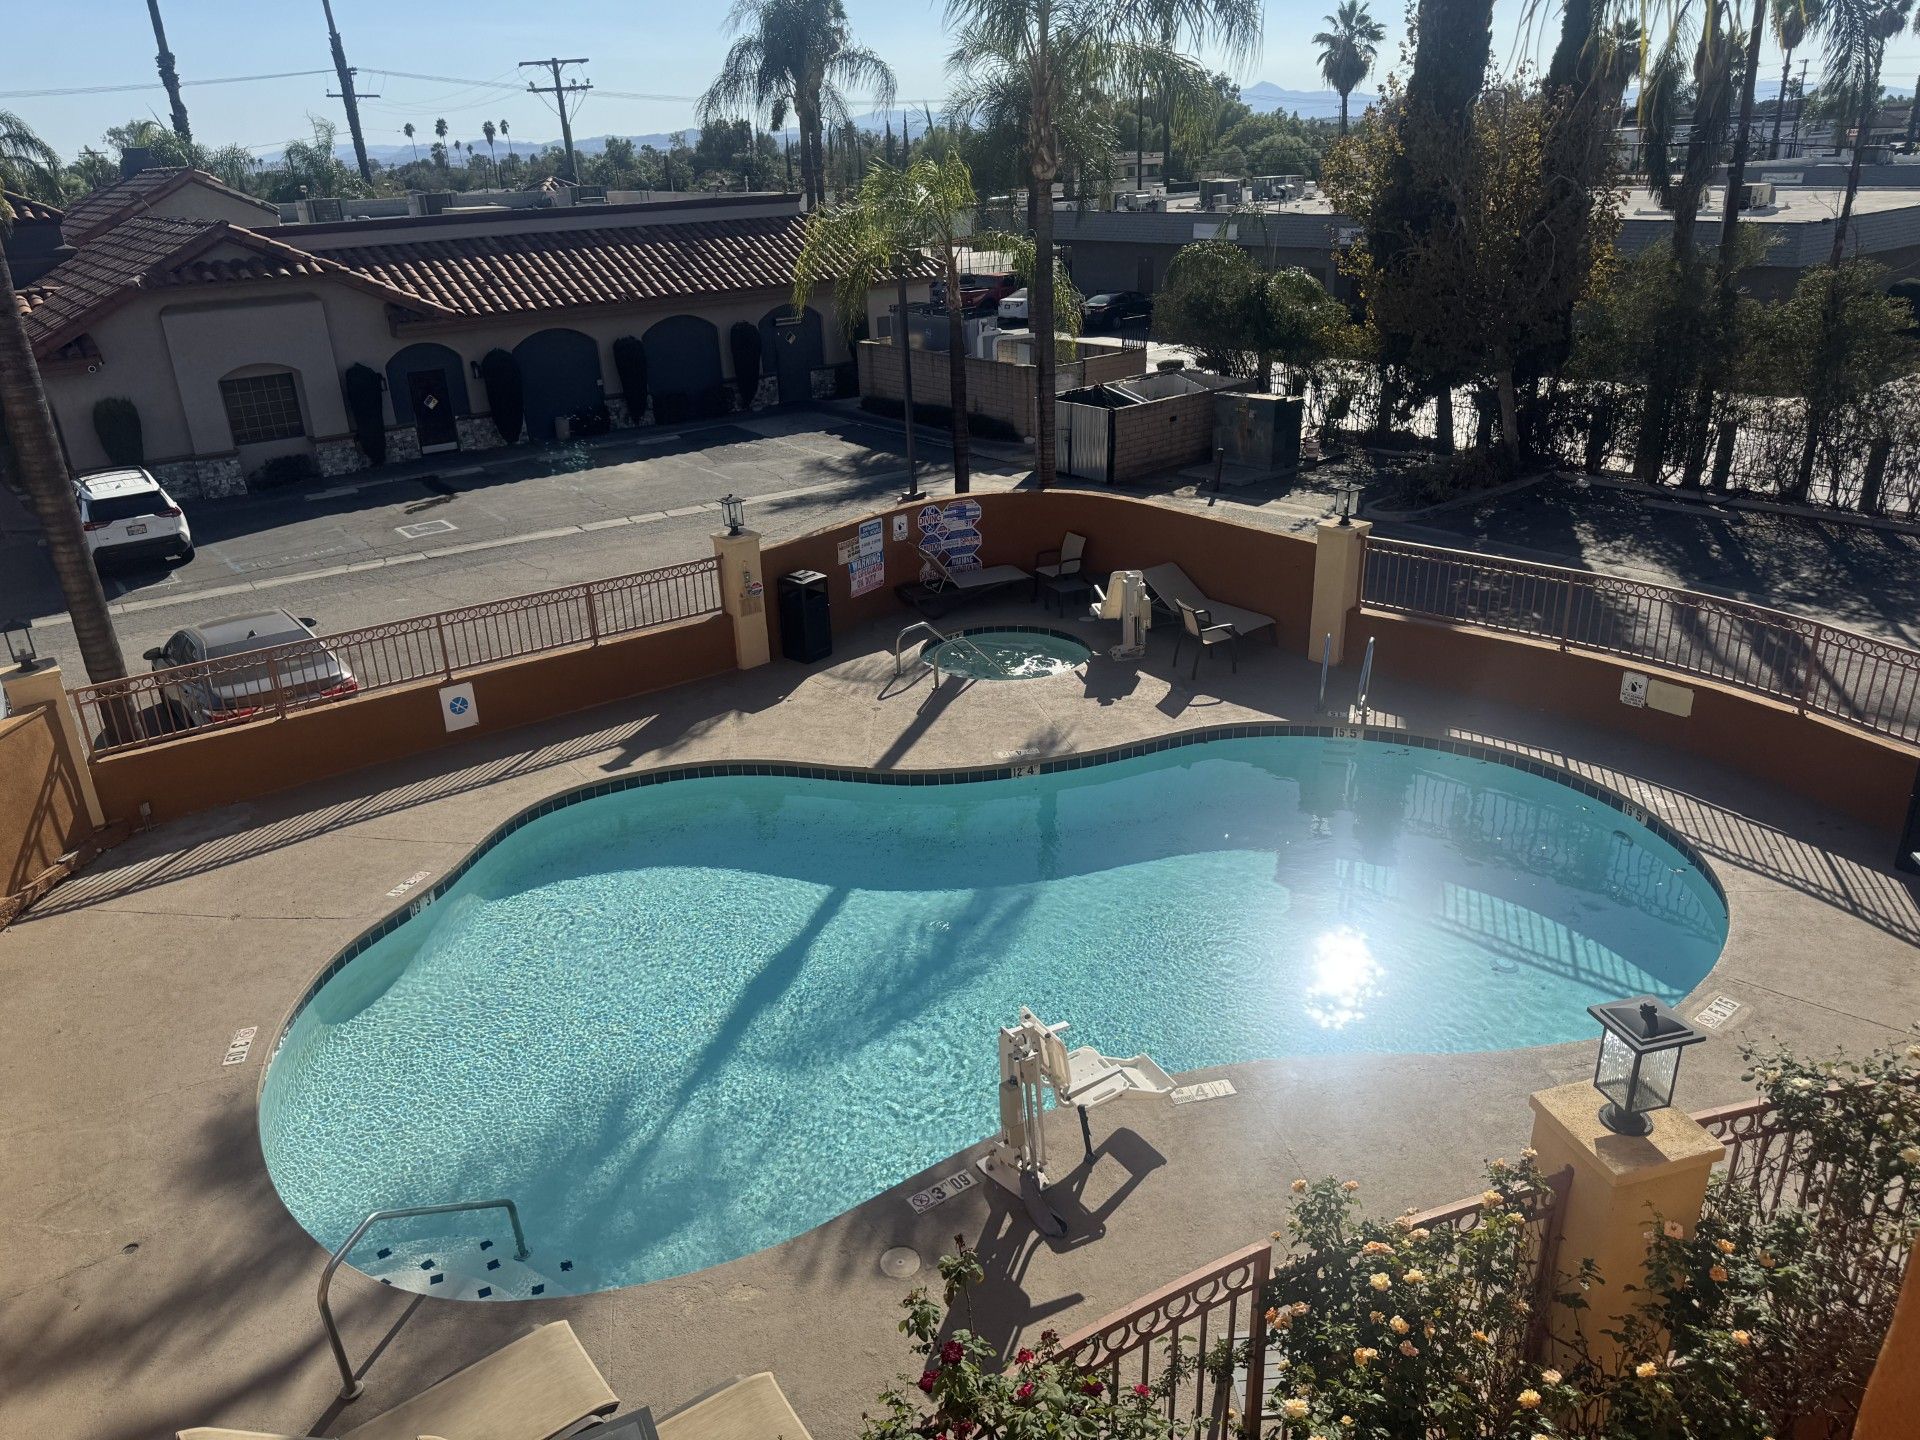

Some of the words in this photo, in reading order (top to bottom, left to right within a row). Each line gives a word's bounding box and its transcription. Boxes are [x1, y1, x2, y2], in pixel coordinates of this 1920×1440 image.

[925, 506, 936, 515] NO
[919, 515, 942, 525] DIVING
[930, 1187, 946, 1200] 3
